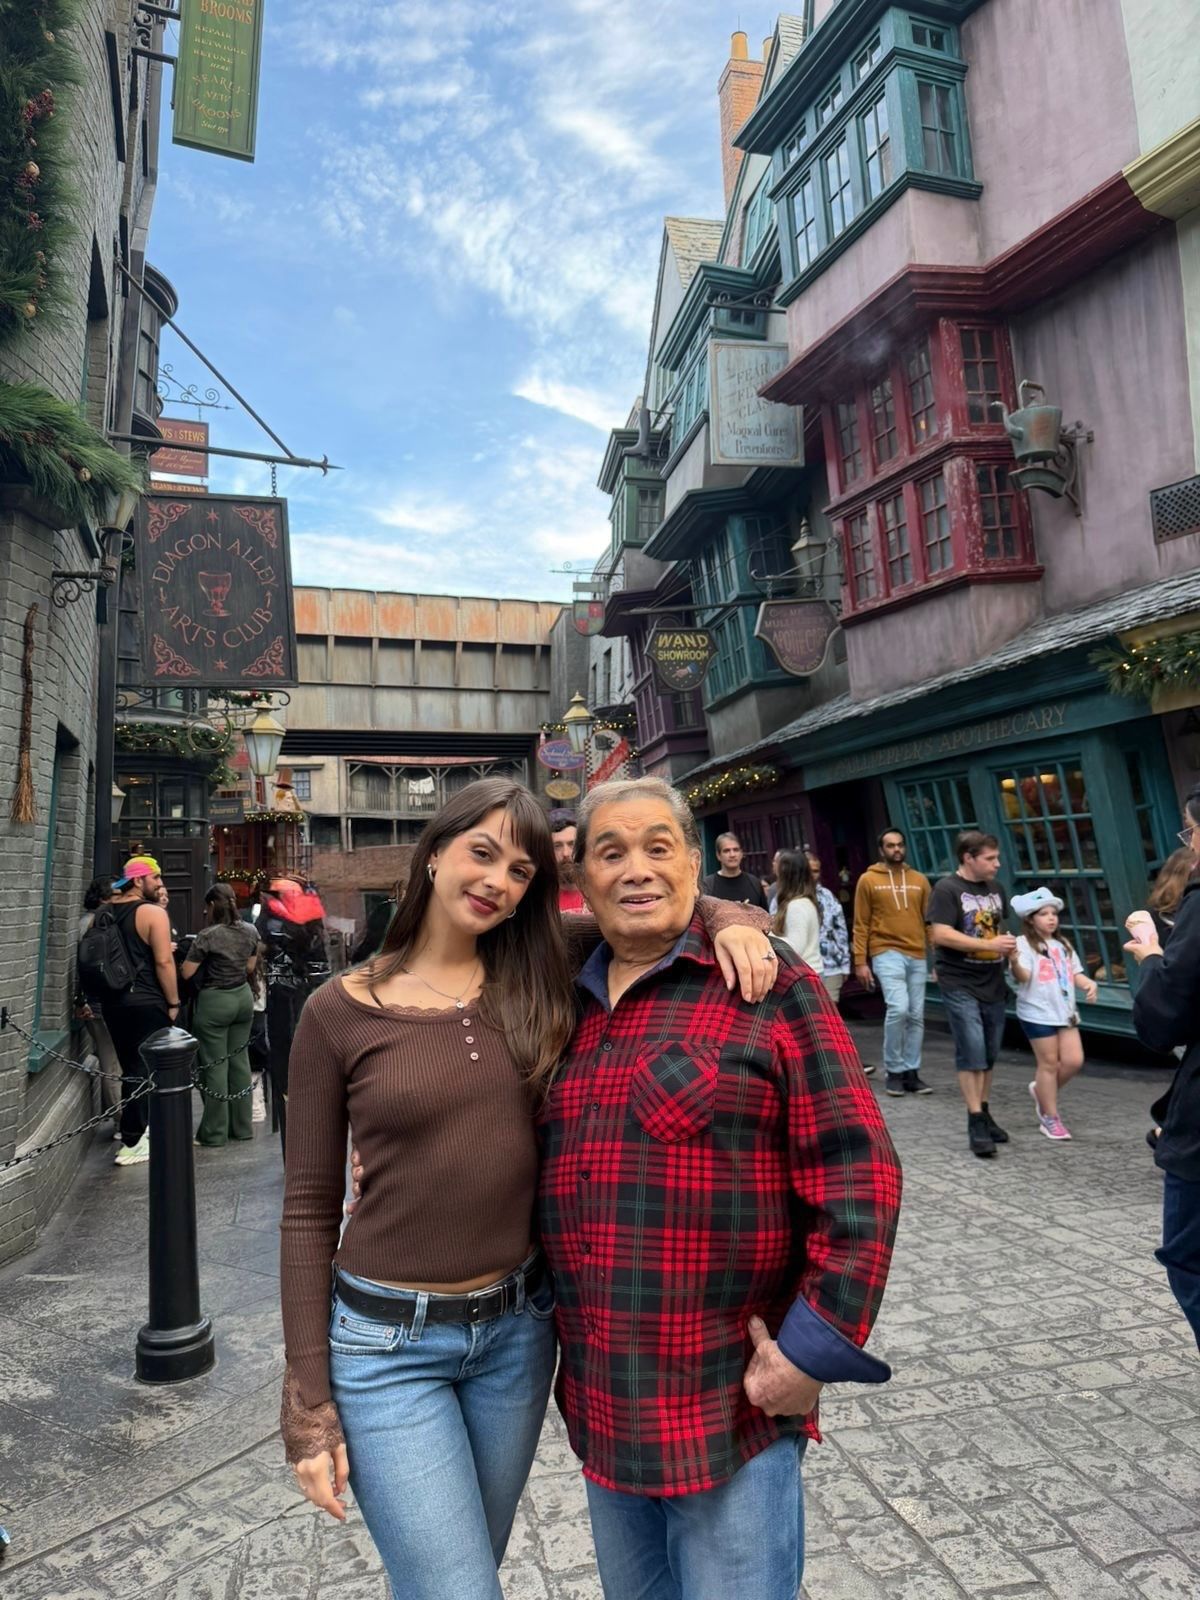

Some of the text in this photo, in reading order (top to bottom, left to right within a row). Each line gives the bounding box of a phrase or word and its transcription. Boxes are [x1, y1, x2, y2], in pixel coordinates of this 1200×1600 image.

[200, 0, 253, 25] BROOMS
[178, 430, 206, 443] STEWS
[727, 421, 761, 439] Magical
[735, 439, 786, 455] Preventions
[152, 533, 279, 588] DIAGON ALLEY
[160, 605, 273, 648] ARTS CLUB
[657, 634, 709, 649] WAND
[657, 650, 709, 661] SHOWROOM
[939, 704, 1067, 752] APOTHECARY
